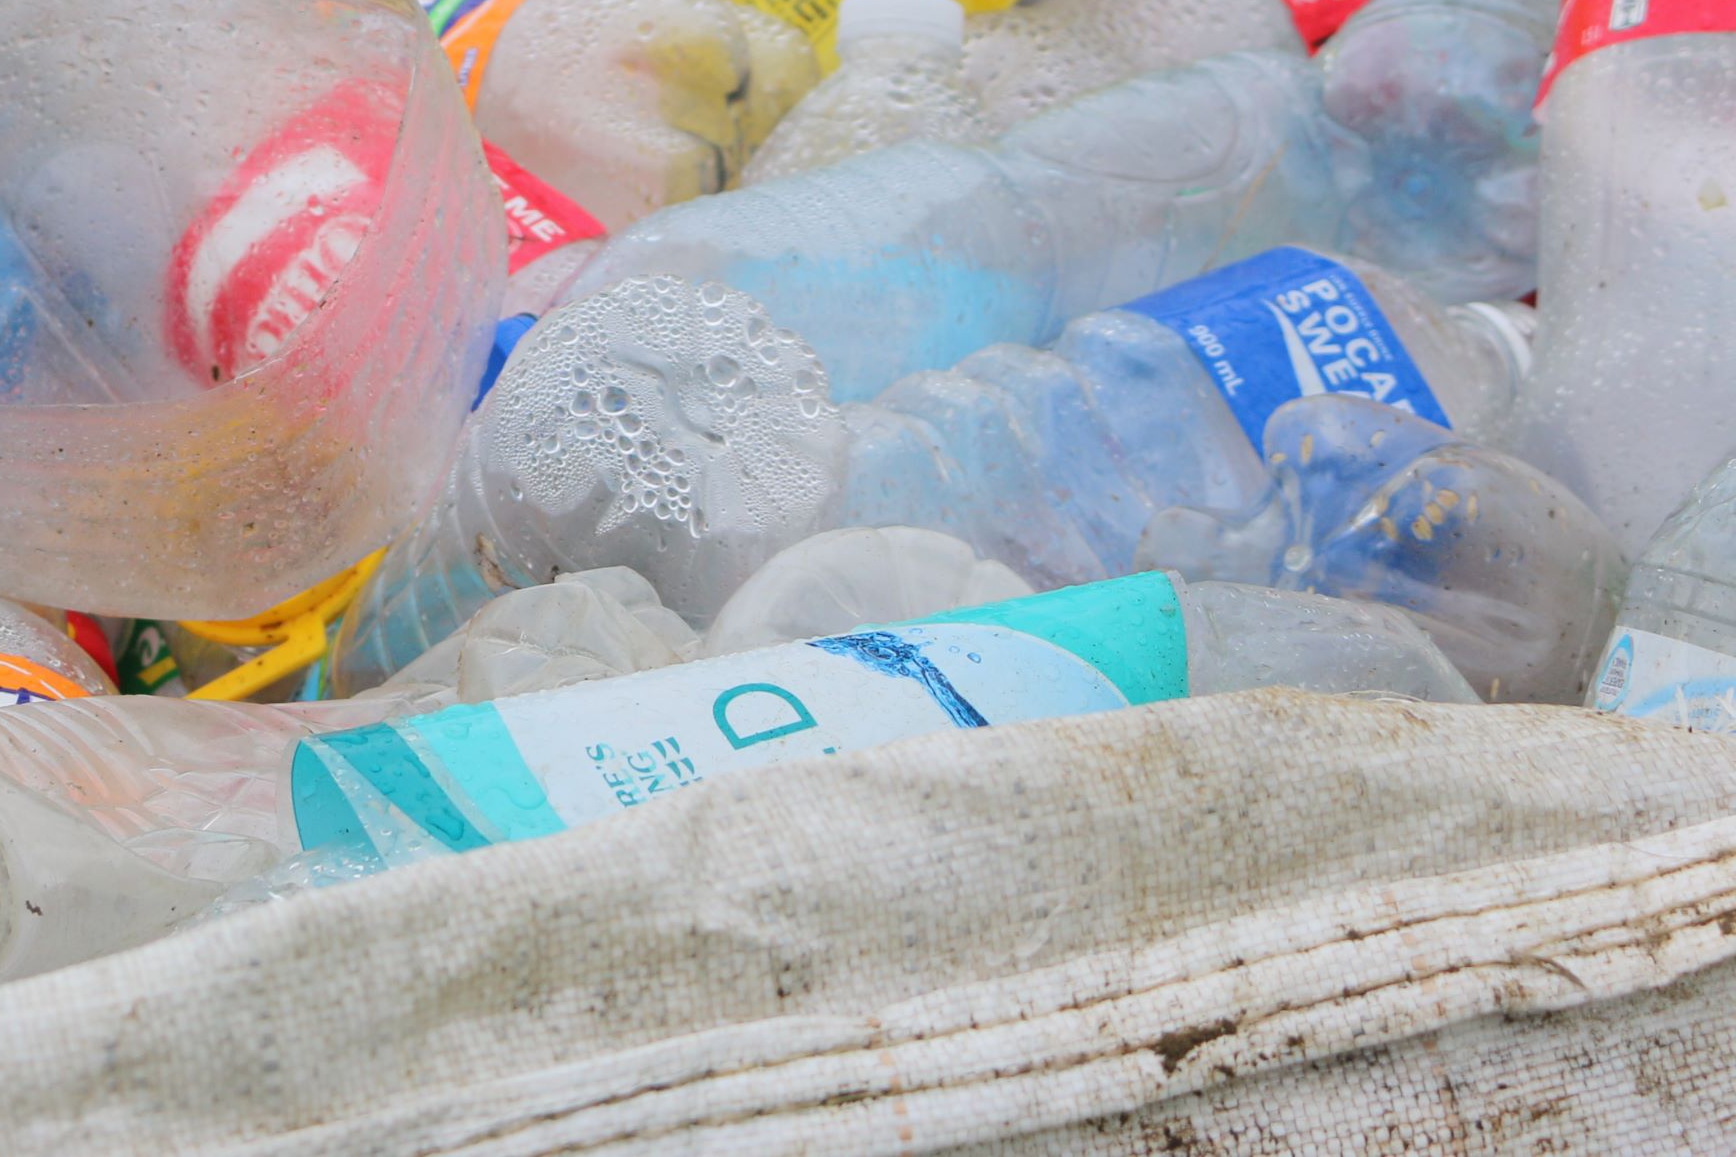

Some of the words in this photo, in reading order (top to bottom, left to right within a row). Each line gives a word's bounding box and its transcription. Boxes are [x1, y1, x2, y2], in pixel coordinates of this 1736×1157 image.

[504, 195, 567, 243] ME
[1188, 323, 1226, 359] 900
[1276, 289, 1372, 399] SWE
[585, 741, 648, 809] RE'S
[627, 746, 673, 795] NG
